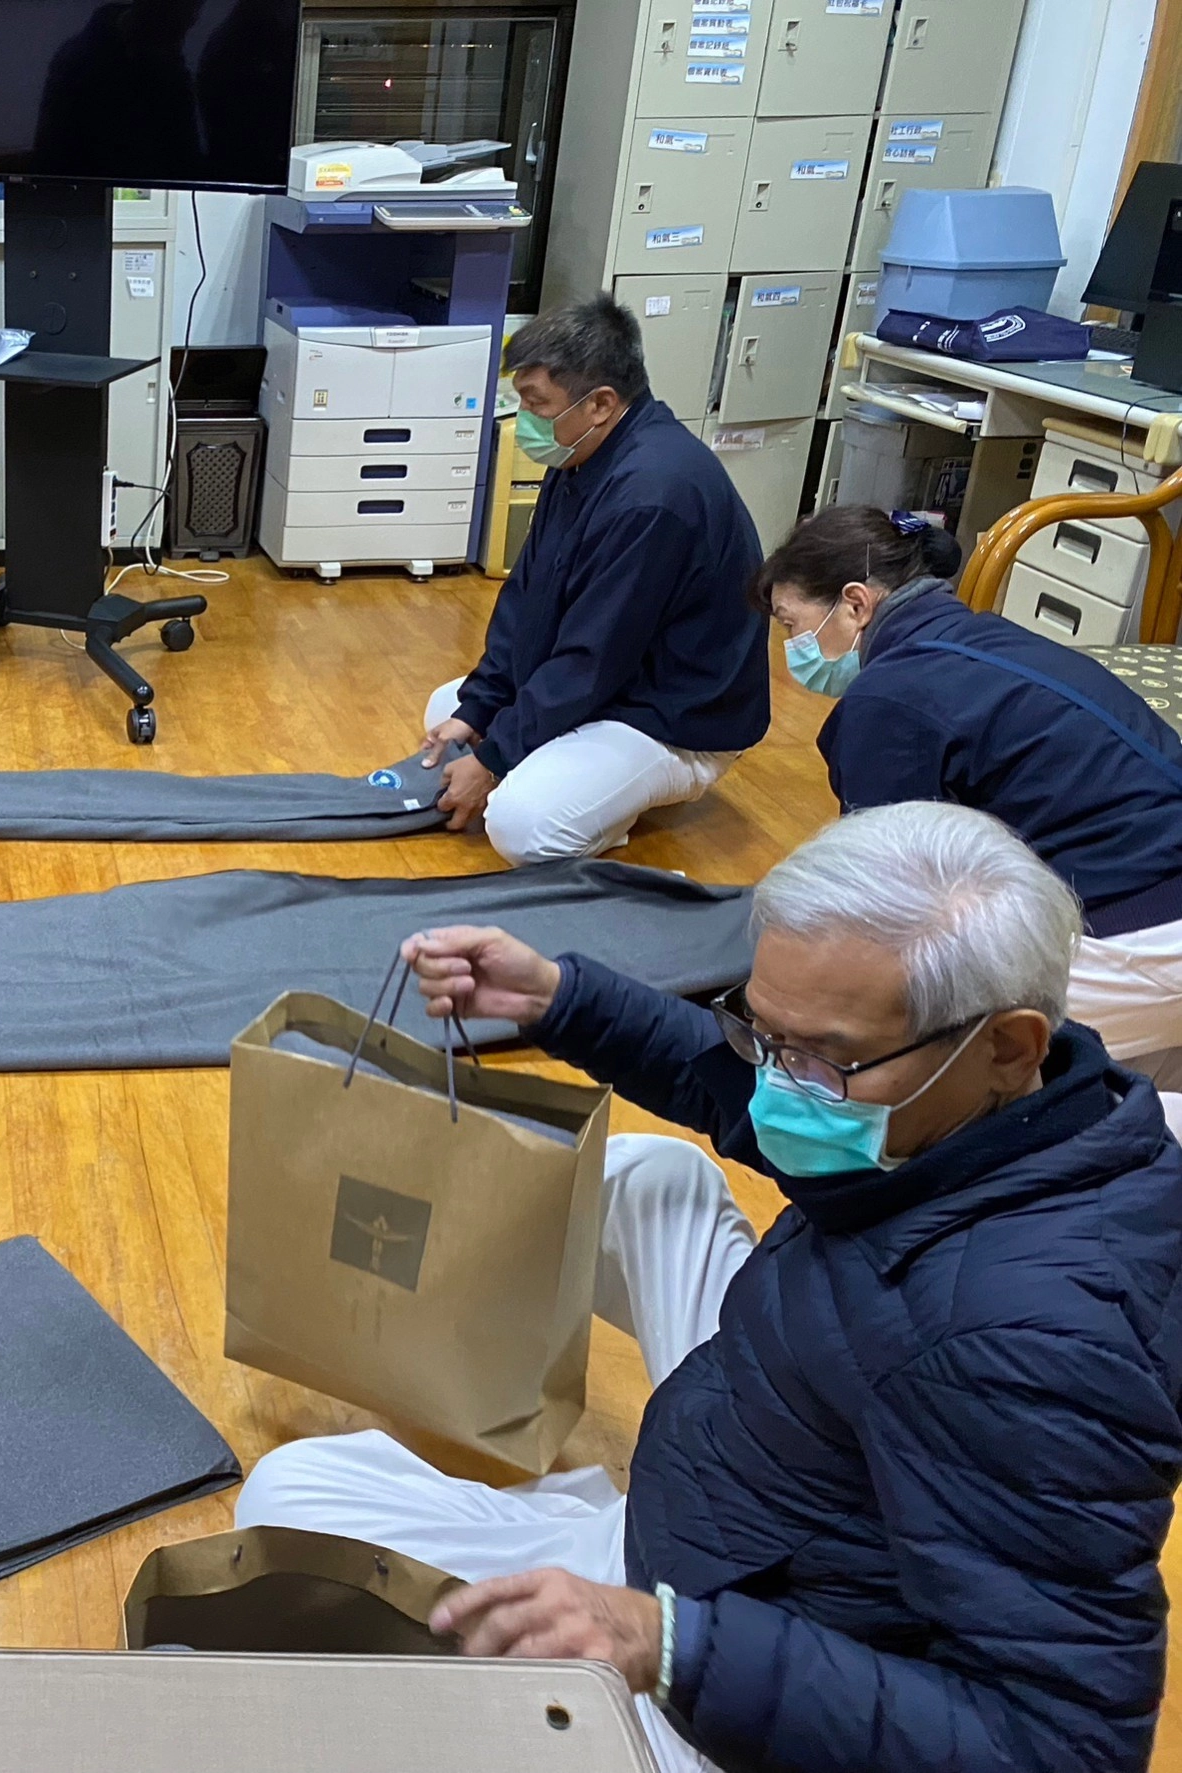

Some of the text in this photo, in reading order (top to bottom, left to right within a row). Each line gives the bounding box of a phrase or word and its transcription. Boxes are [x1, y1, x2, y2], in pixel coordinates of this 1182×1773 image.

[796, 164, 826, 175] 和氣二
[652, 231, 681, 244] 和氣三
